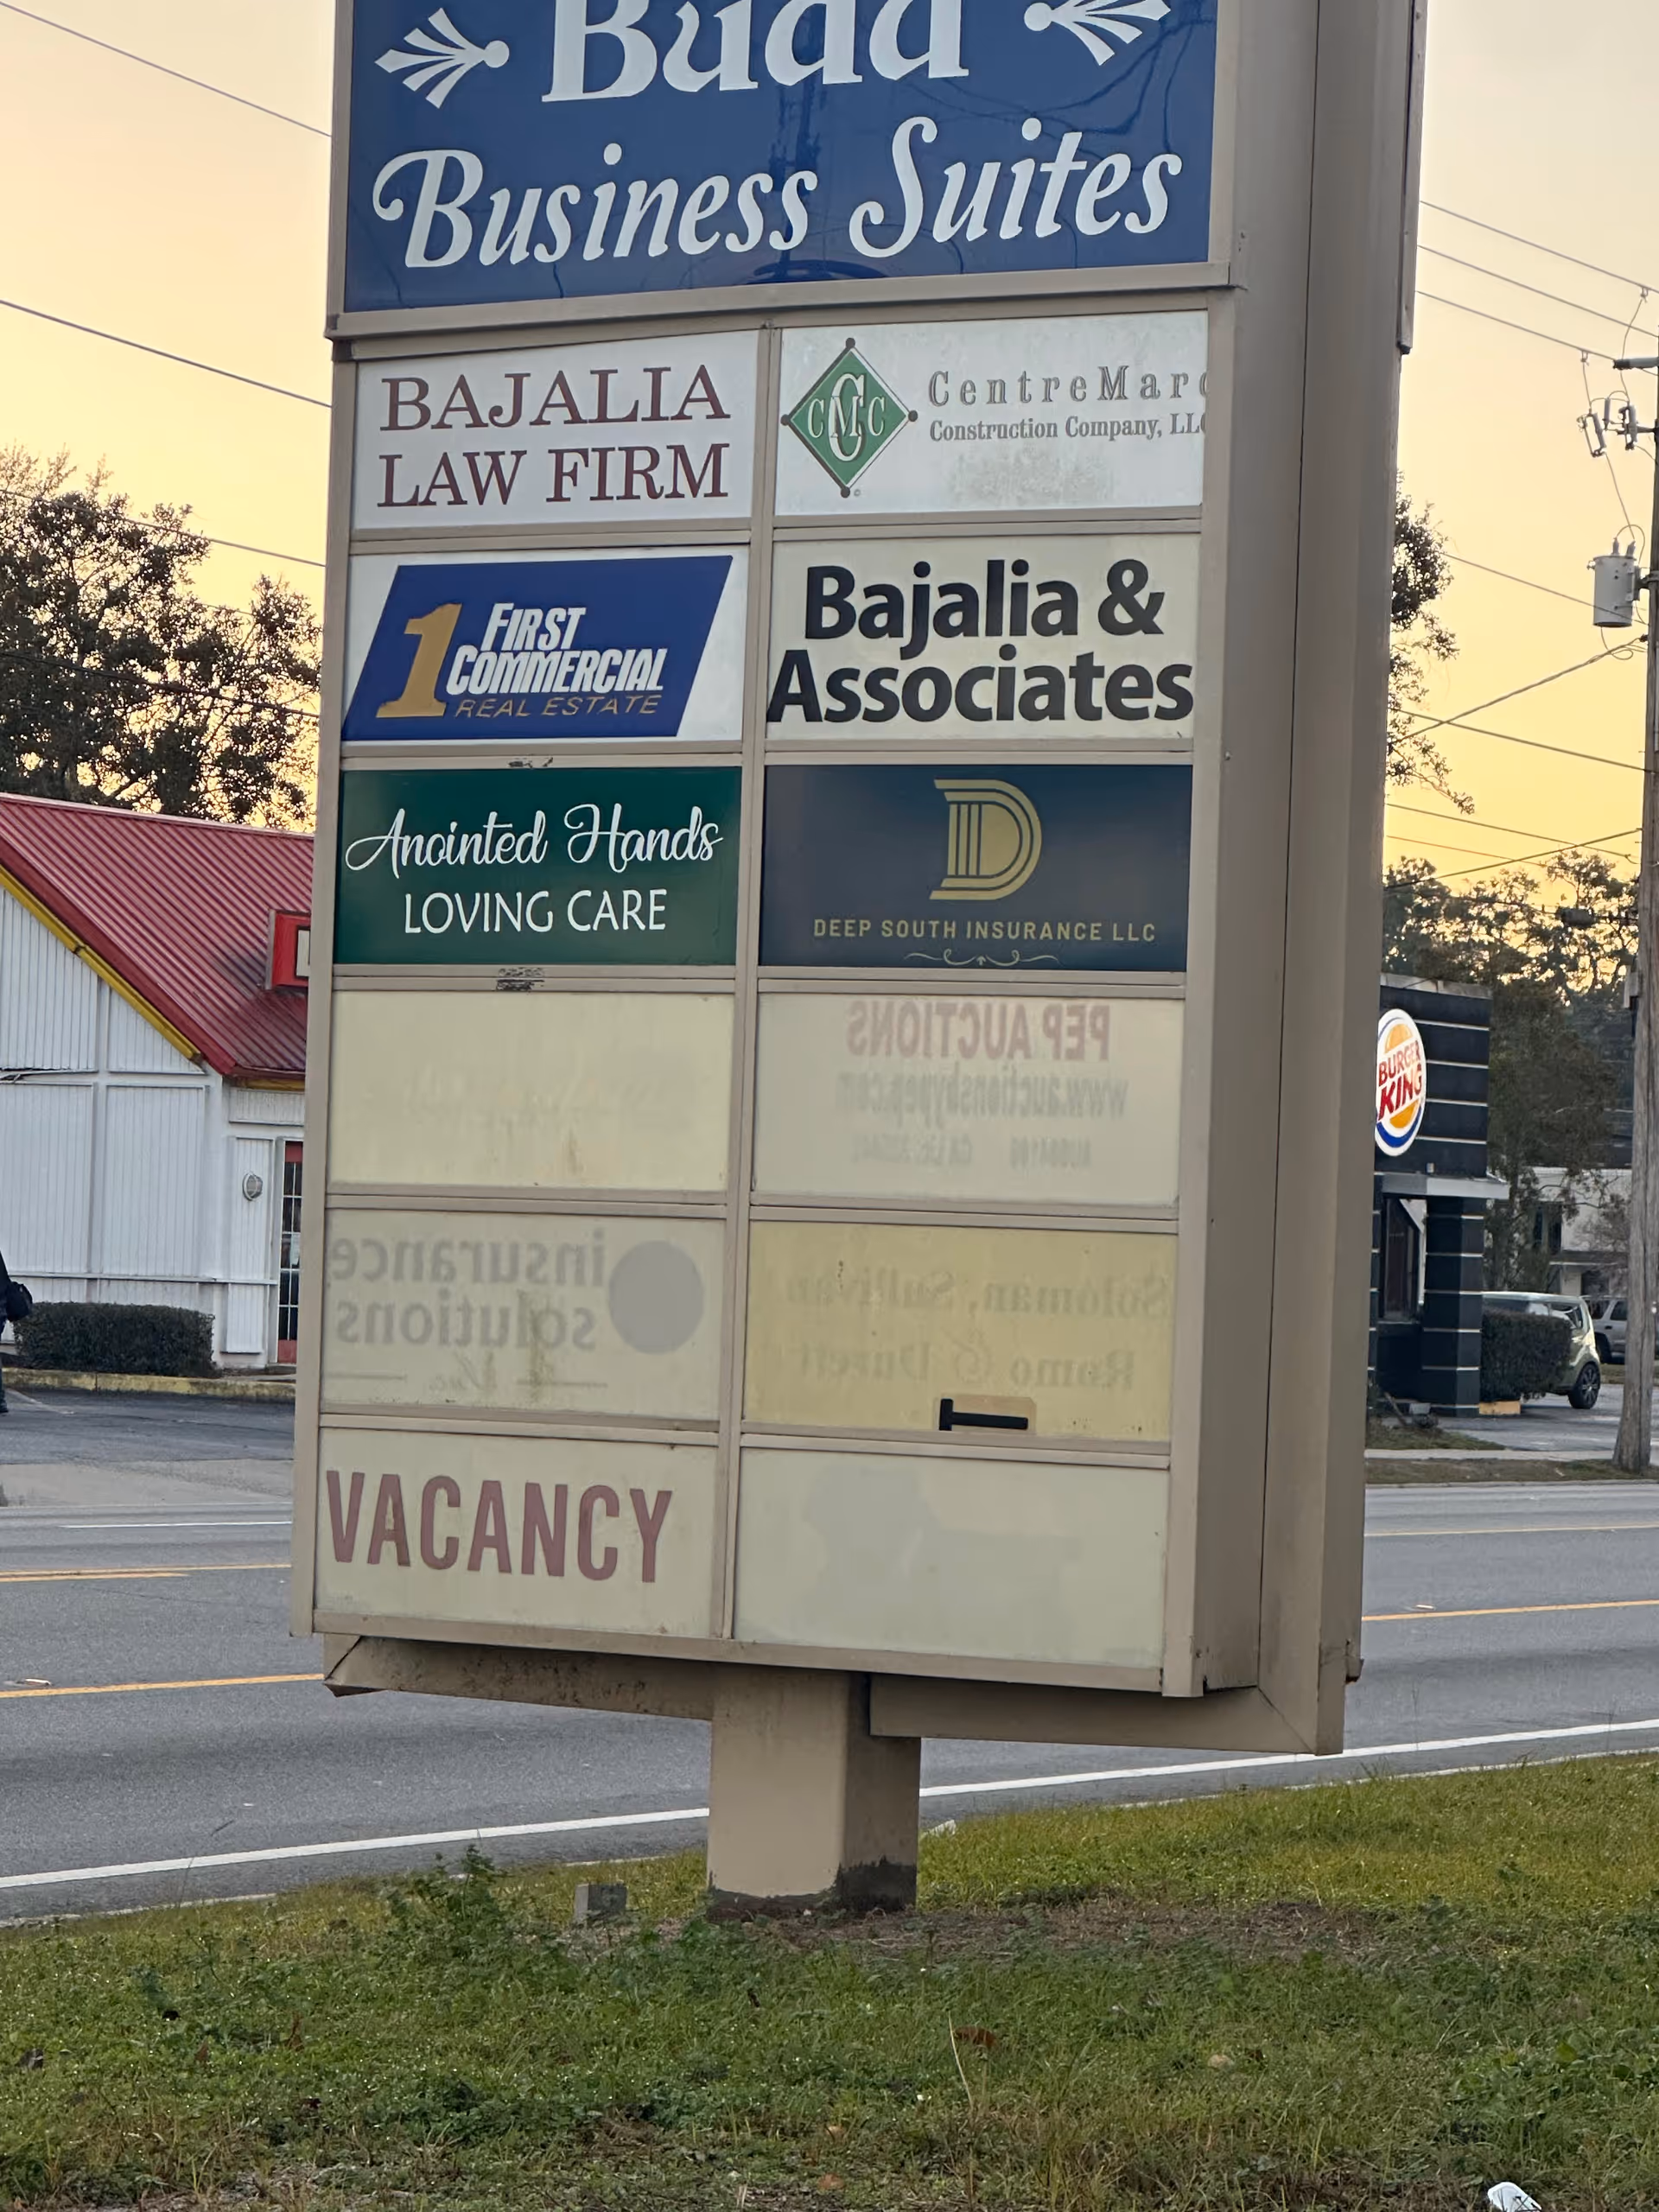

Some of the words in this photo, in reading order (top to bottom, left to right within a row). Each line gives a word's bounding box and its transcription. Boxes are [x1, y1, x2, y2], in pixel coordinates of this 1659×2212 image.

[372, 143, 817, 269] Business
[849, 117, 1182, 258] Suites
[379, 364, 731, 431] BAJALIA
[929, 416, 1058, 442] Construction
[1065, 415, 1163, 442] Company,
[377, 449, 528, 508] LAW
[546, 442, 730, 502] FIRM
[804, 559, 1078, 660] Bajalia
[1097, 559, 1166, 636] &
[375, 603, 462, 718] 1
[446, 645, 668, 695] COMMERCIAL
[766, 644, 1194, 722] Associates
[454, 697, 531, 718] REAL
[540, 695, 663, 716] ESTATE
[346, 808, 549, 879] Anointed
[564, 803, 723, 873] Hands
[404, 891, 554, 934] LOVING
[567, 889, 667, 931] CARE
[813, 918, 872, 938] DEEP
[881, 919, 957, 939] SOUTH
[966, 921, 1103, 941] INSURANCE
[1112, 924, 1156, 942] LLC
[1378, 1065, 1422, 1121] KING
[1379, 1040, 1421, 1087] BURGER
[326, 1470, 673, 1583] VACANCY
